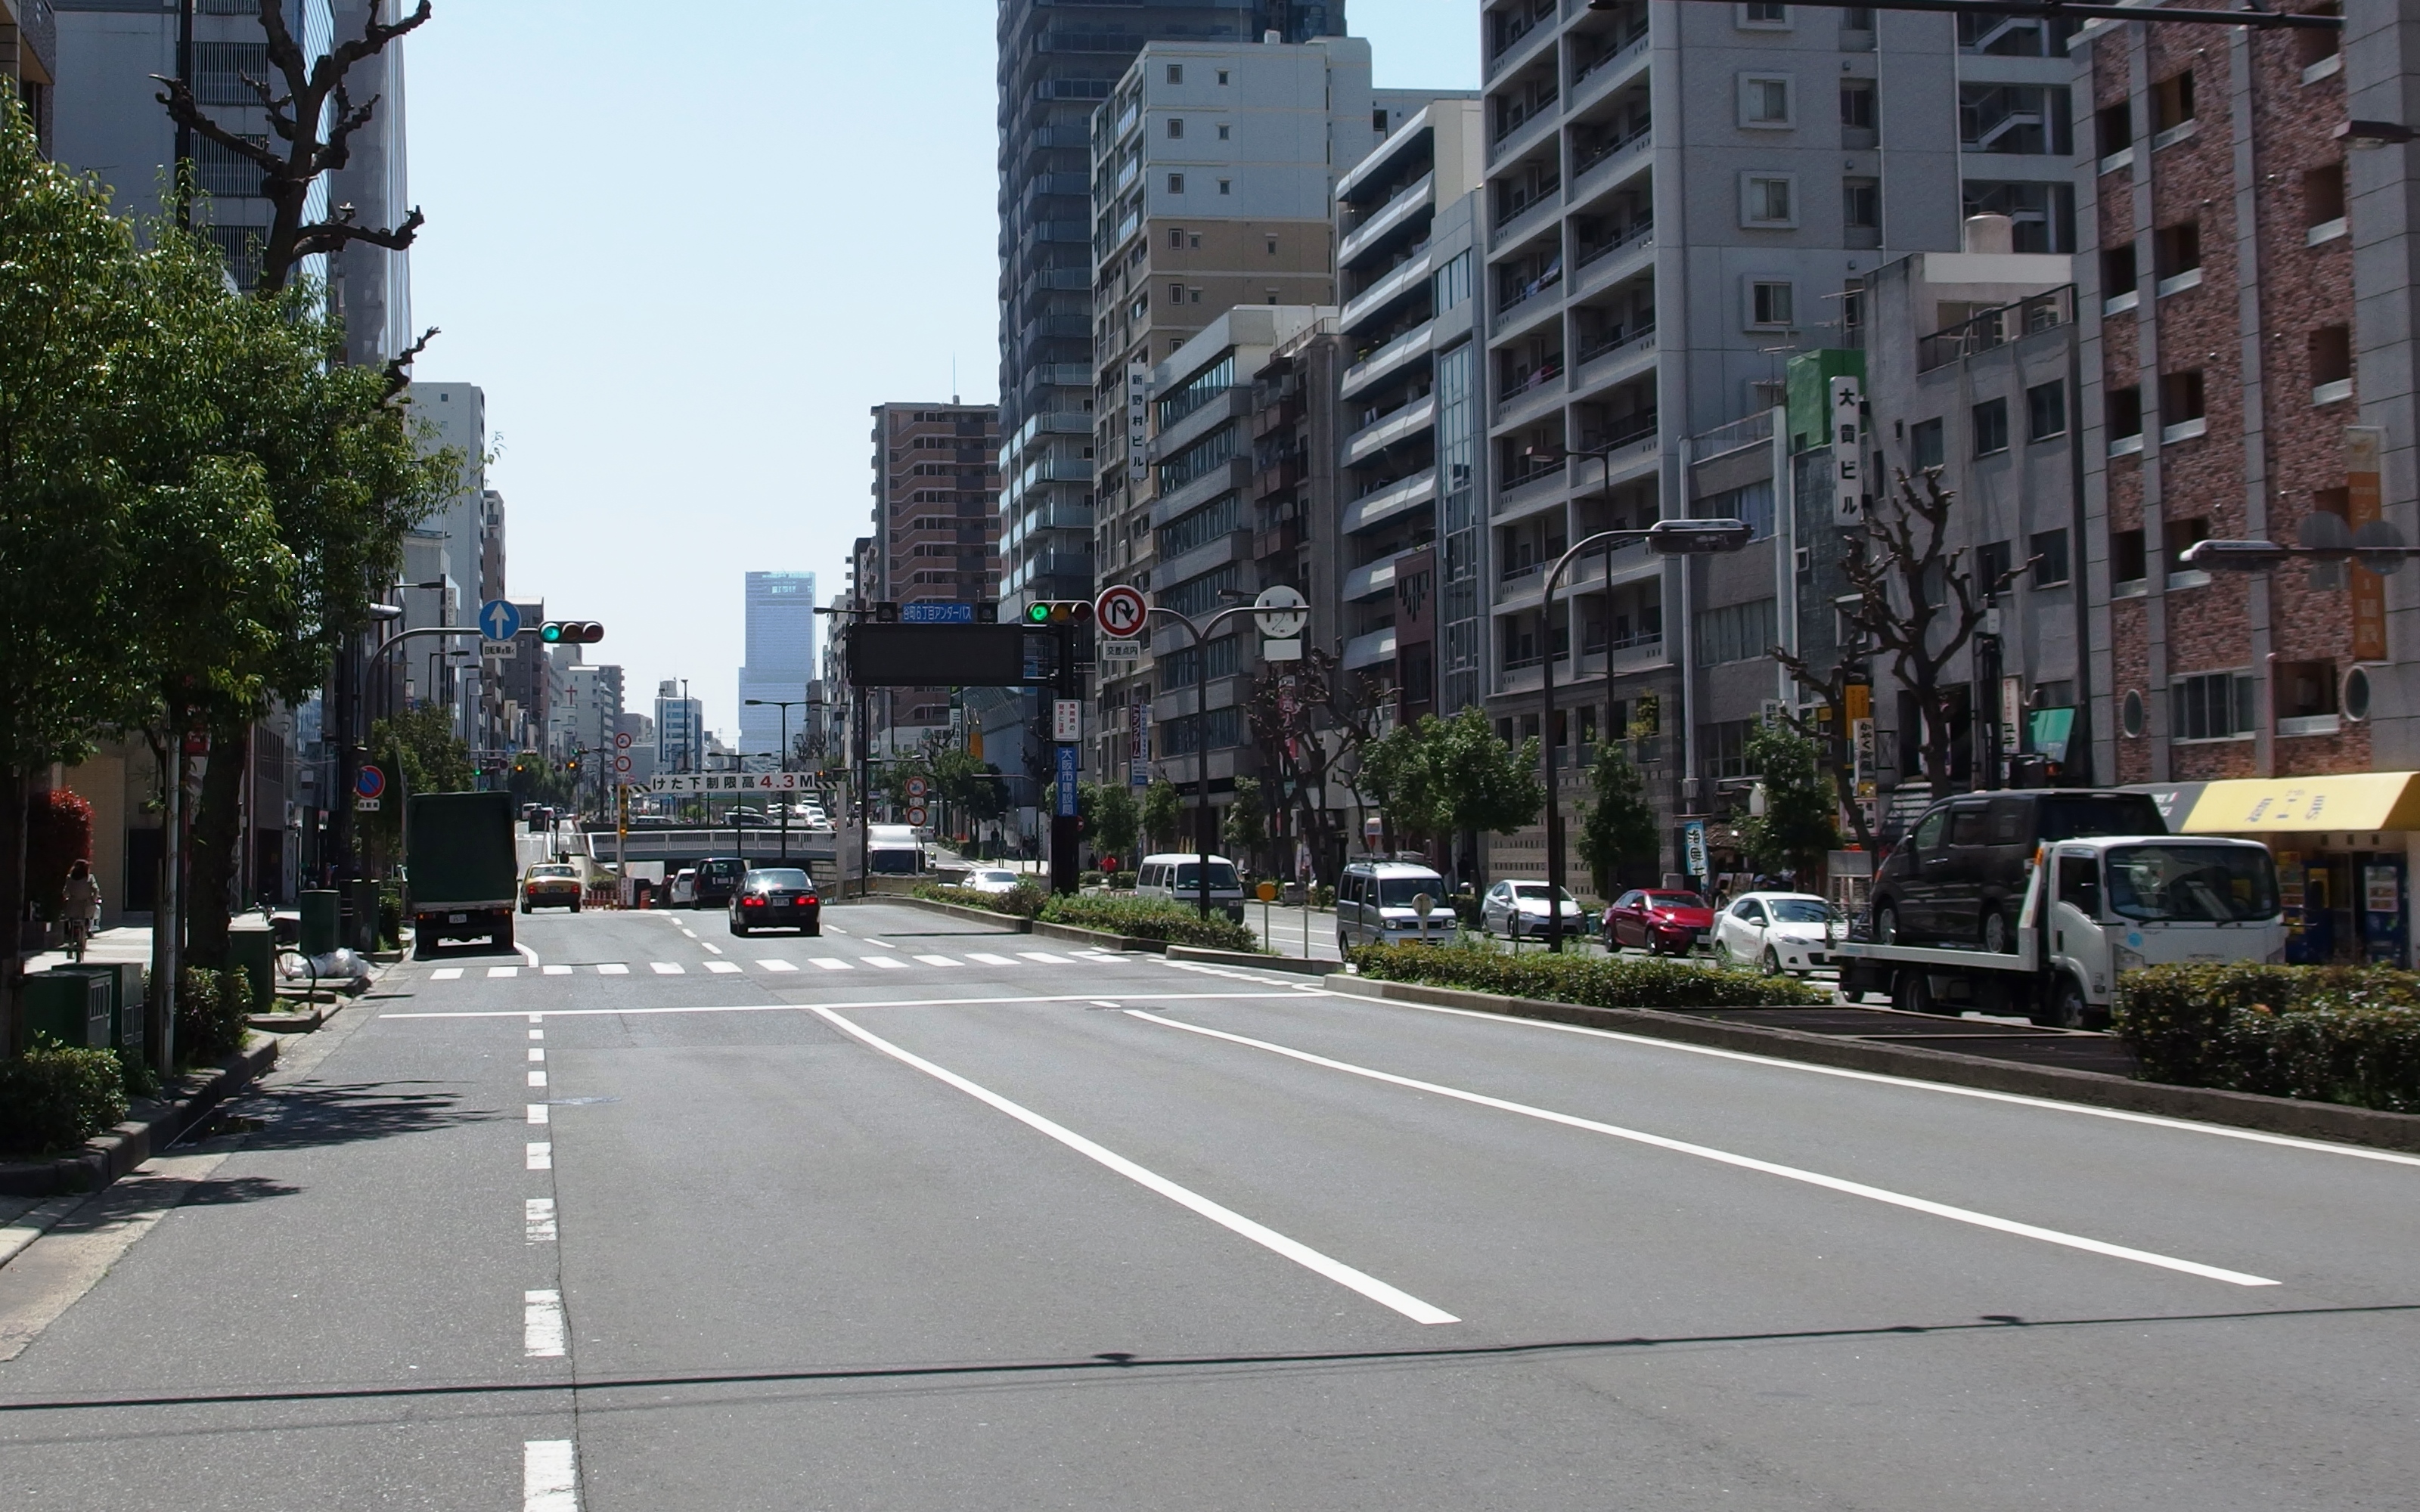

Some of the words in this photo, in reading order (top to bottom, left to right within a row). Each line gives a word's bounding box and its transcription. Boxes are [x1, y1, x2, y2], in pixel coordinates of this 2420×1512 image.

[1132, 374, 1143, 467] 新野村ビル
[1839, 388, 1857, 515] 大貴ビル
[903, 606, 972, 620] 谷町6丁目アンダーパス
[1061, 748, 1074, 816] 大阪市建設局
